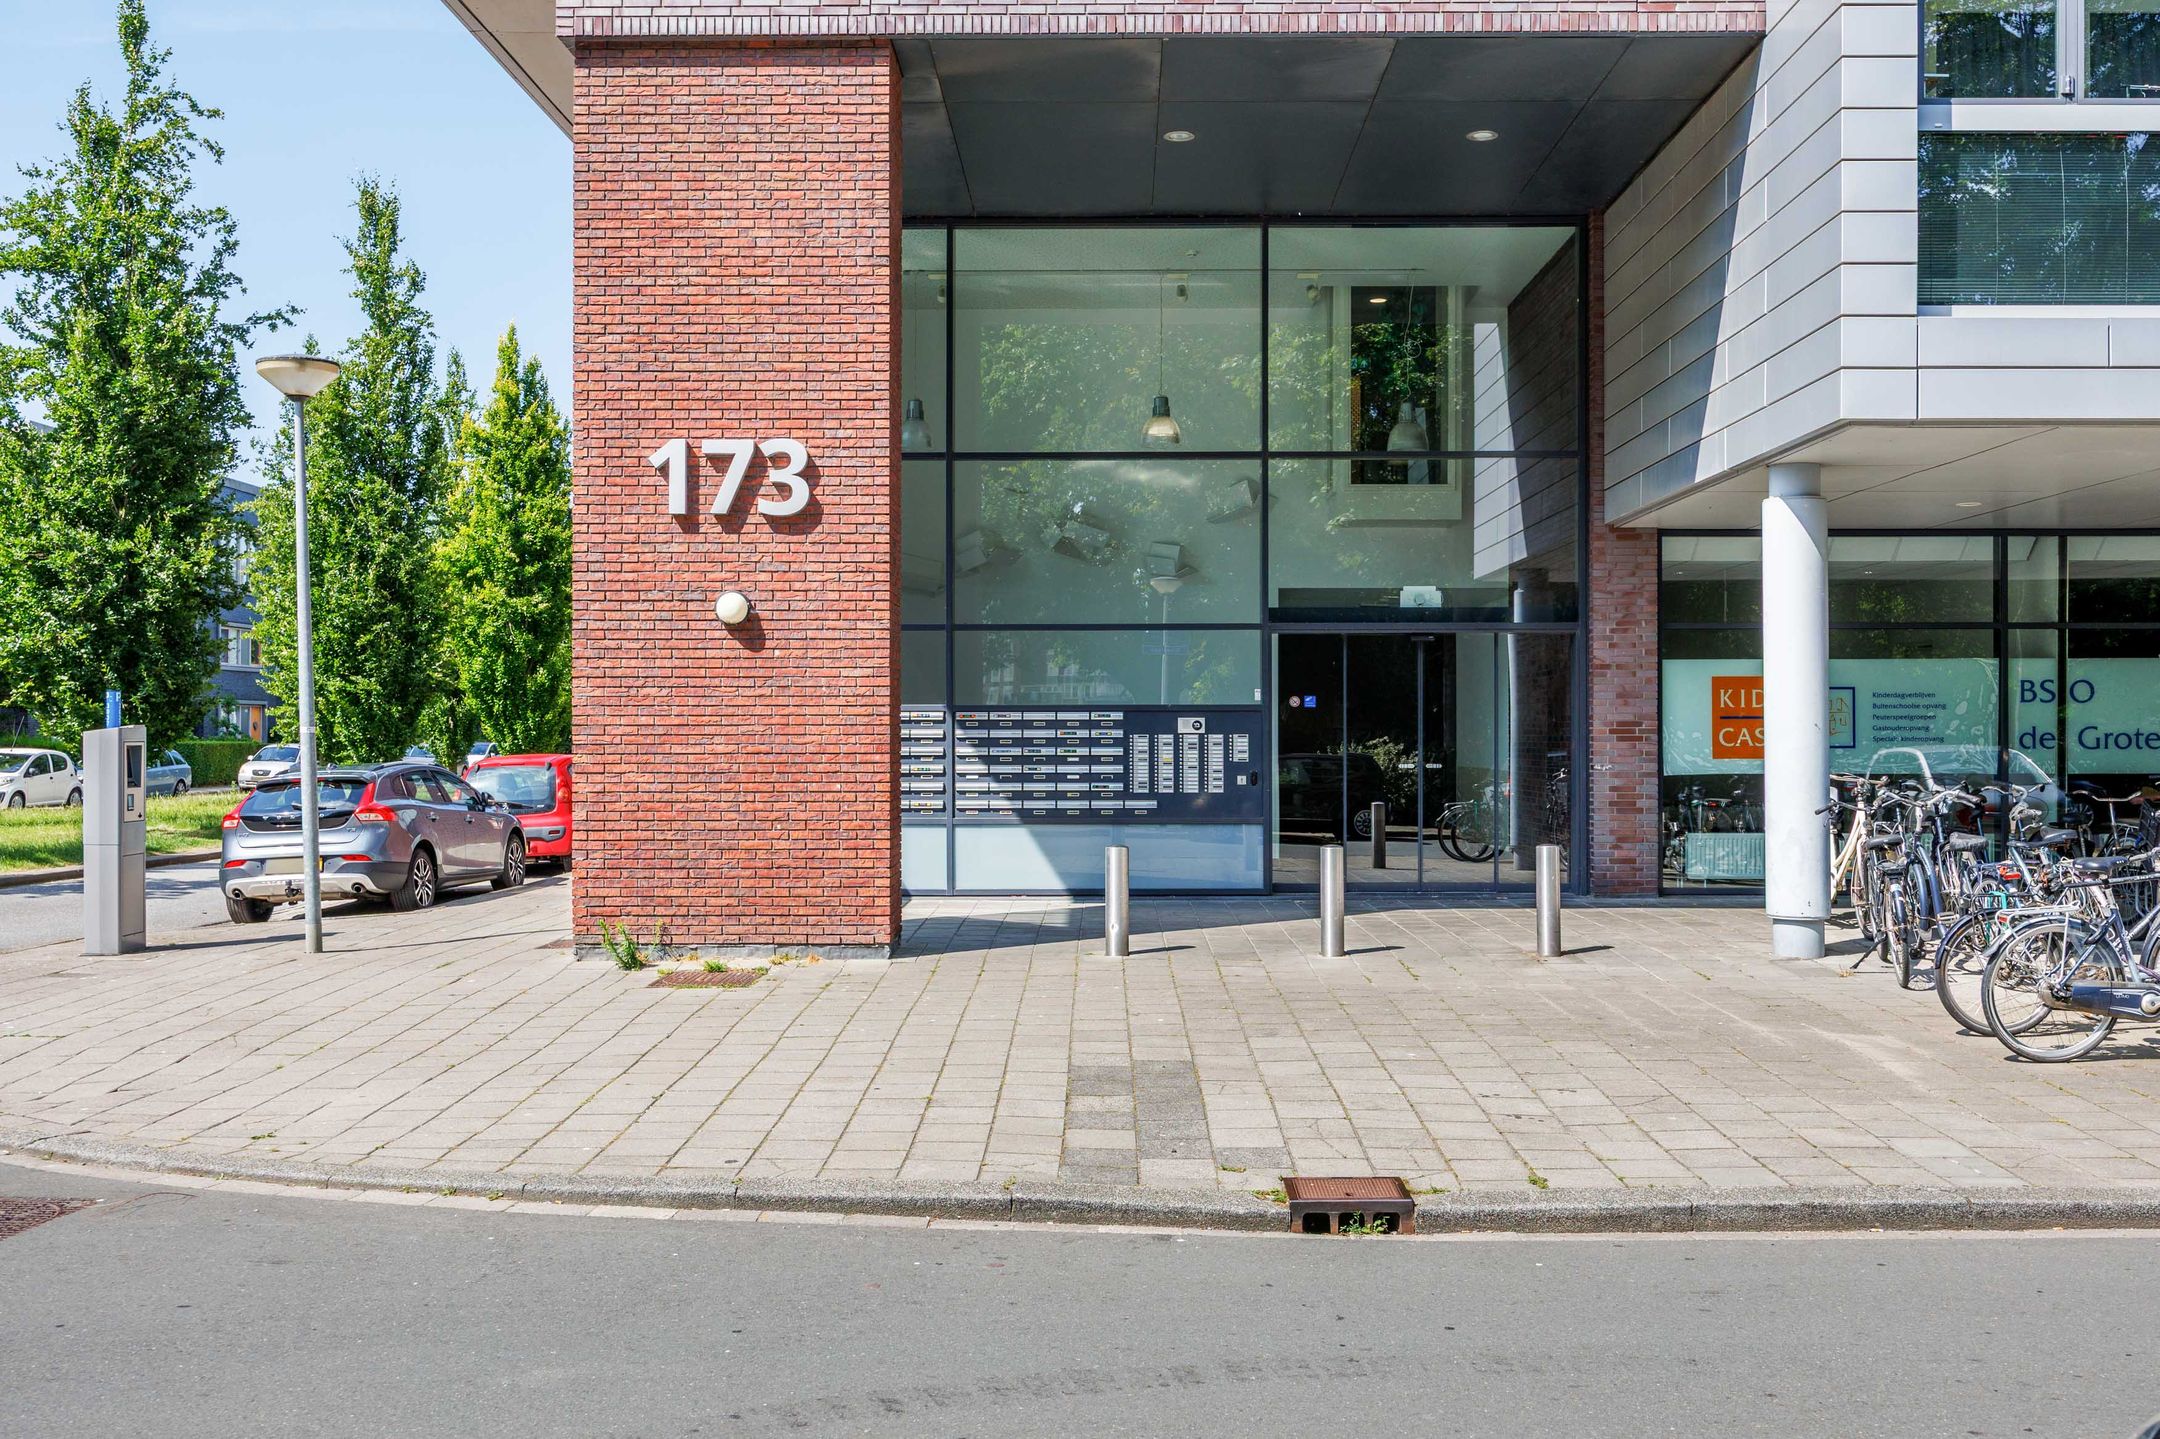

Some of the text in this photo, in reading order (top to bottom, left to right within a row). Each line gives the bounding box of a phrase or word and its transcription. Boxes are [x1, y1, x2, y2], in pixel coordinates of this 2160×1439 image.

[648, 438, 810, 517] 173
[1872, 691, 1936, 700] Kinderdagverblijven
[2020, 679, 2095, 704] BSO
[1921, 703, 1947, 711] opvang
[1872, 725, 1930, 733] Gastouderopvang
[1900, 735, 1945, 744] kinderopvang
[2018, 726, 2160, 750] de Grote
